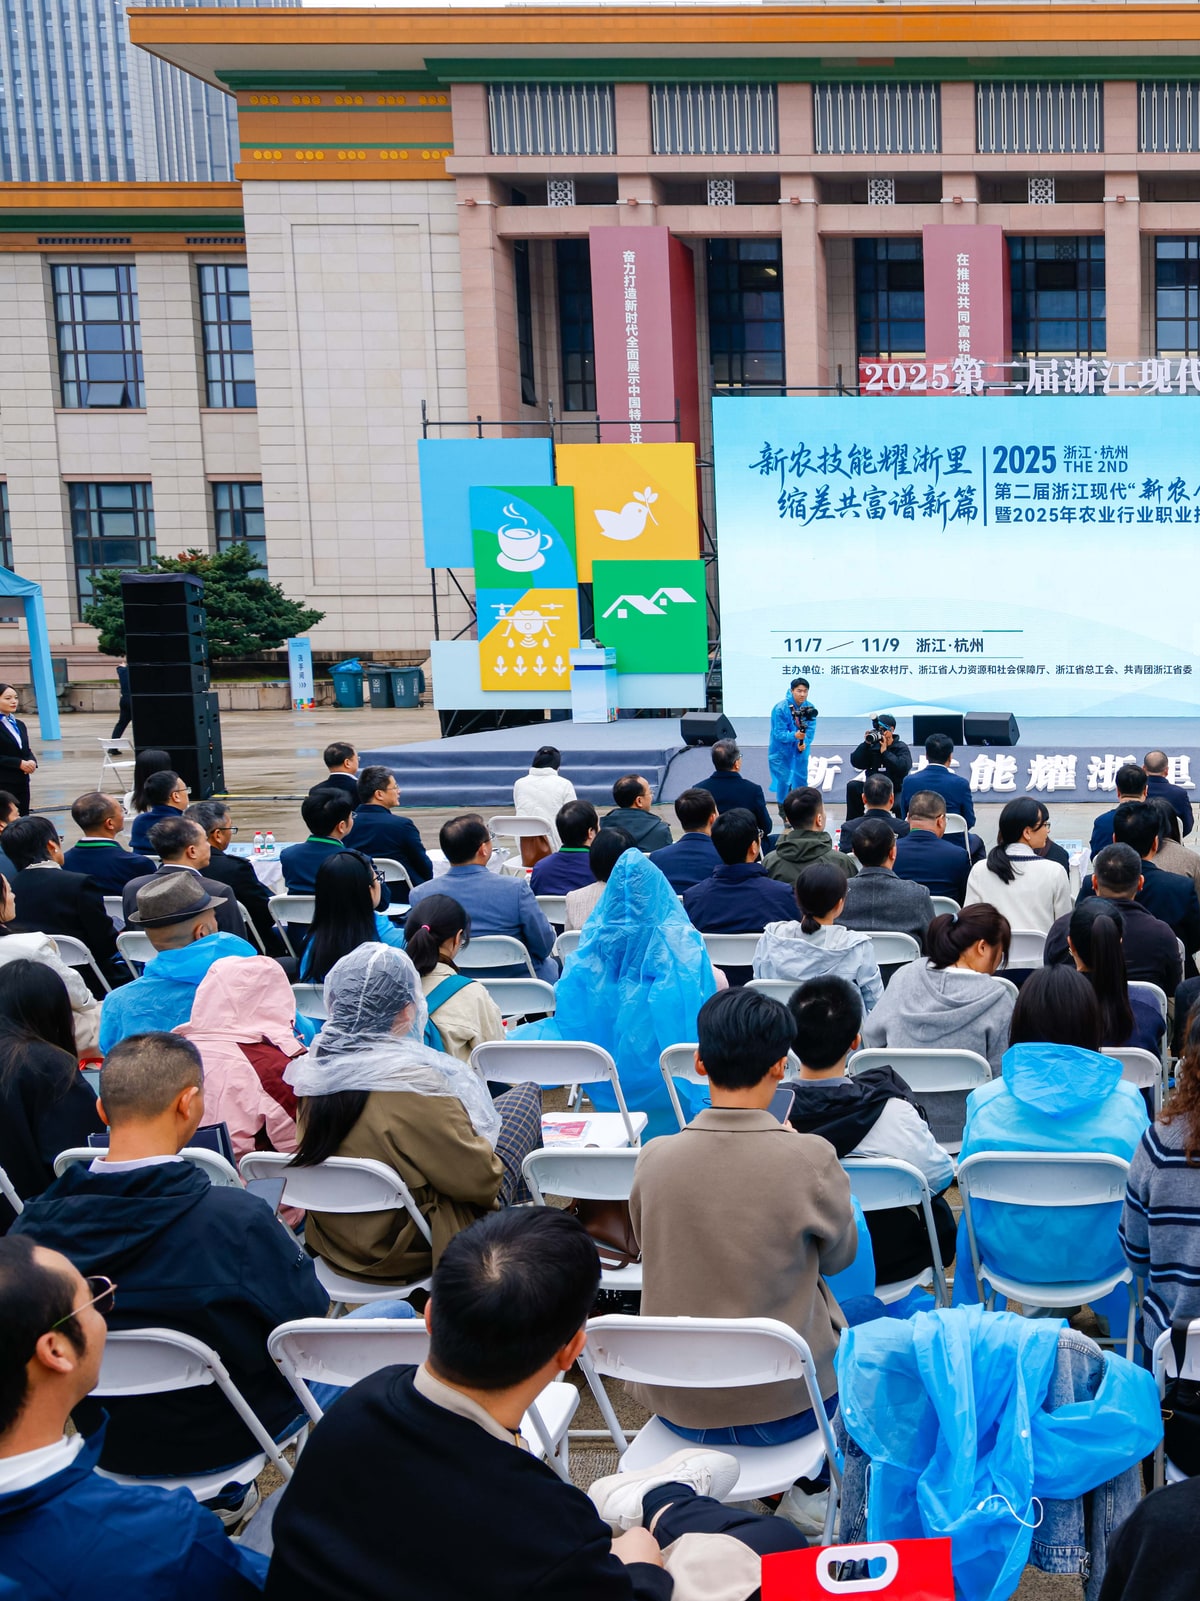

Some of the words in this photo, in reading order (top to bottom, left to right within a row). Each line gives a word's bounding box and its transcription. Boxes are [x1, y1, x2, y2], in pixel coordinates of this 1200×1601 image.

[992, 445, 1057, 474] 2025
[1063, 445, 1129, 460] 浙江·杭州
[1063, 460, 1094, 473] THE
[1097, 460, 1129, 473] 2ND
[784, 637, 822, 652] 11/7
[861, 637, 900, 652] 11/9
[916, 637, 984, 653] 浙江·杭州
